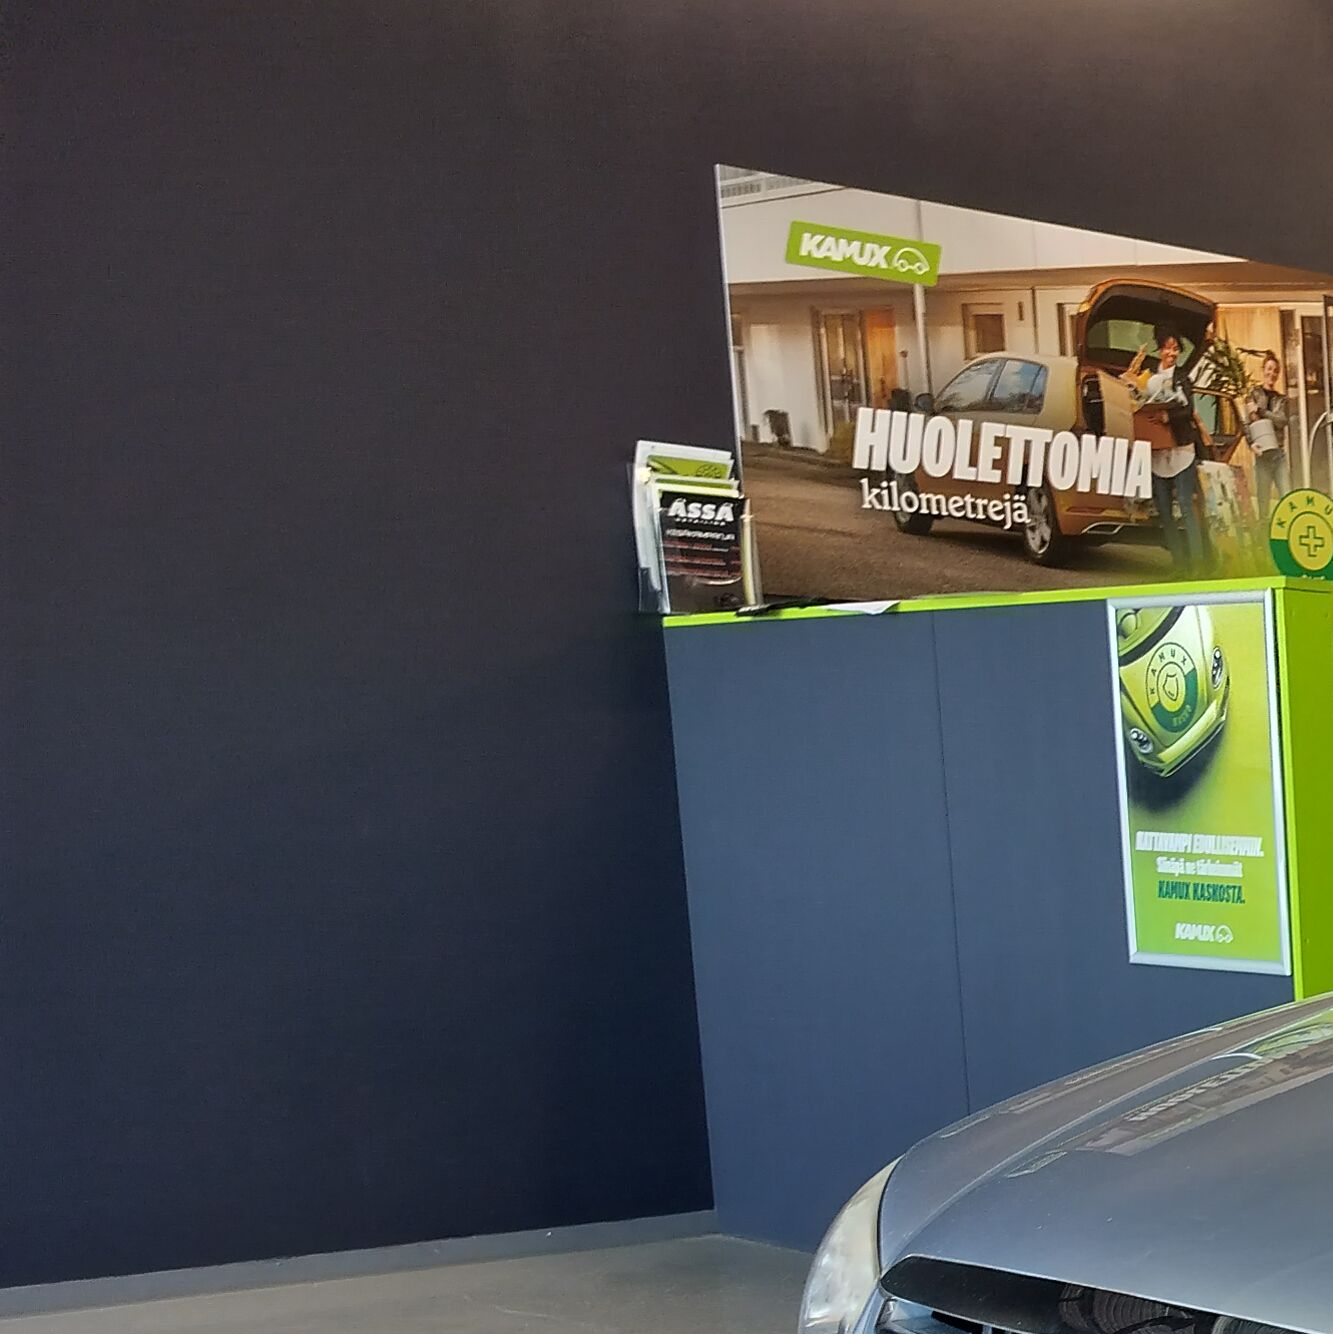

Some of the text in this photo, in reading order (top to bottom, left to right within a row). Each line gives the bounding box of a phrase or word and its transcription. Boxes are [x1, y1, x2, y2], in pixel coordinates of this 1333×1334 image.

[799, 232, 892, 269] KAMUX
[852, 407, 1152, 499] HUOLETTOMIA
[860, 478, 1033, 530] kilometrejä
[1157, 879, 1191, 900] KAMUX
[1175, 922, 1217, 942] KAMUX
